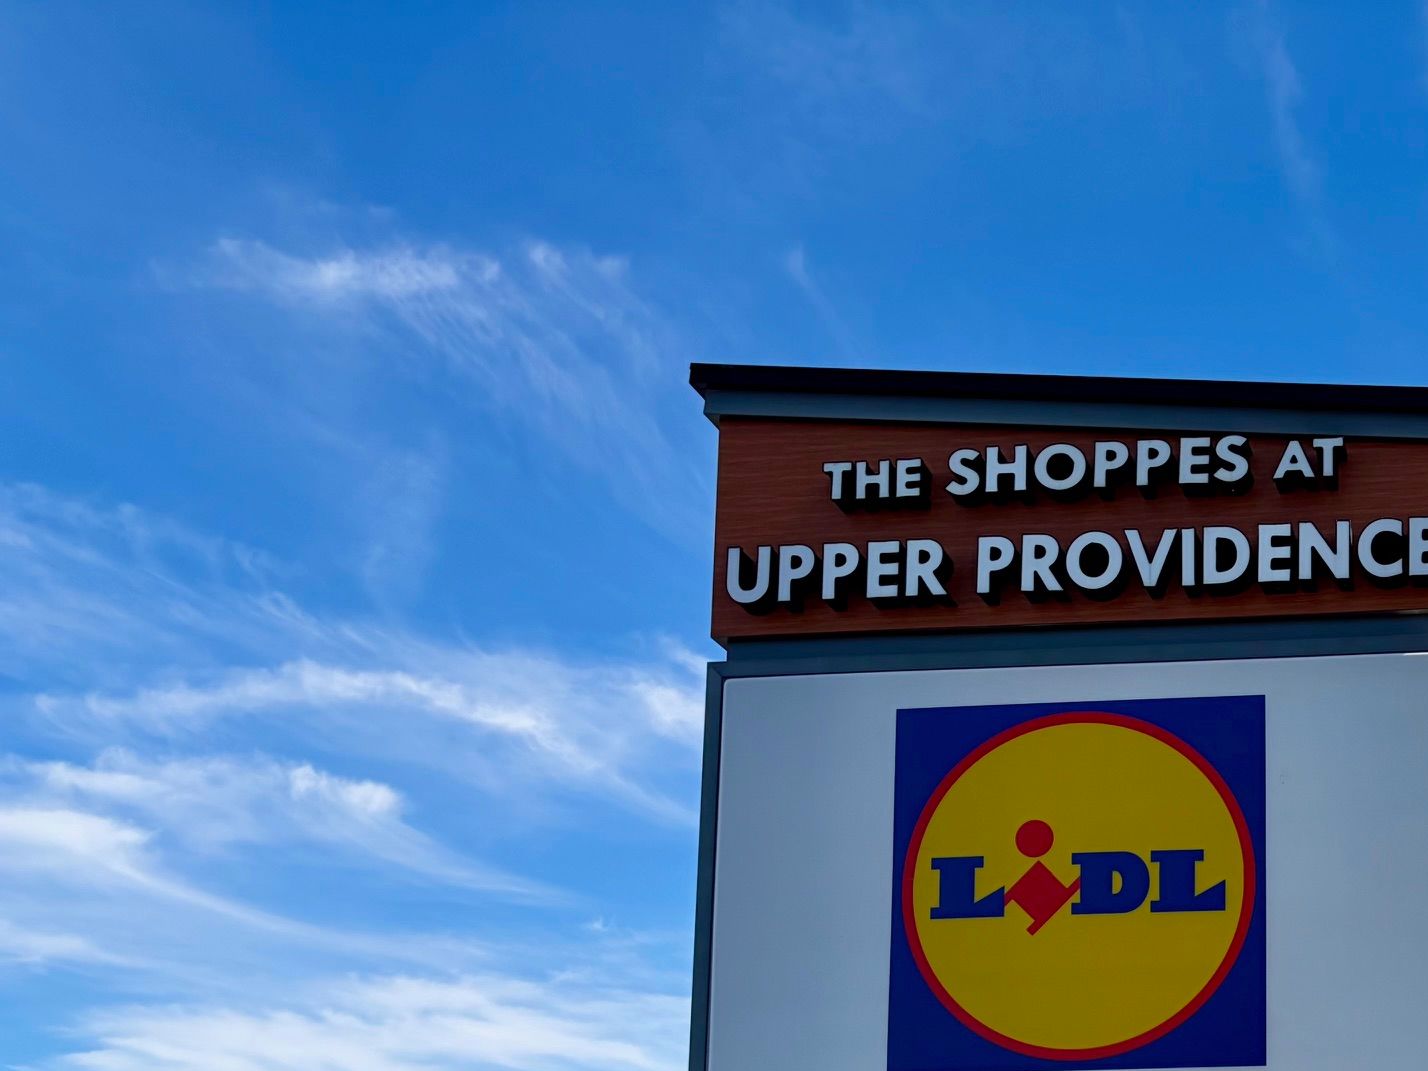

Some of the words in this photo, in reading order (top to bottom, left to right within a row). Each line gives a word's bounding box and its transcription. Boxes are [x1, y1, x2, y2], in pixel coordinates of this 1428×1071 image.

[823, 458, 921, 499] THE
[945, 435, 1249, 495] SHOPPES
[1273, 437, 1344, 479] AT
[726, 539, 947, 603] UPPER
